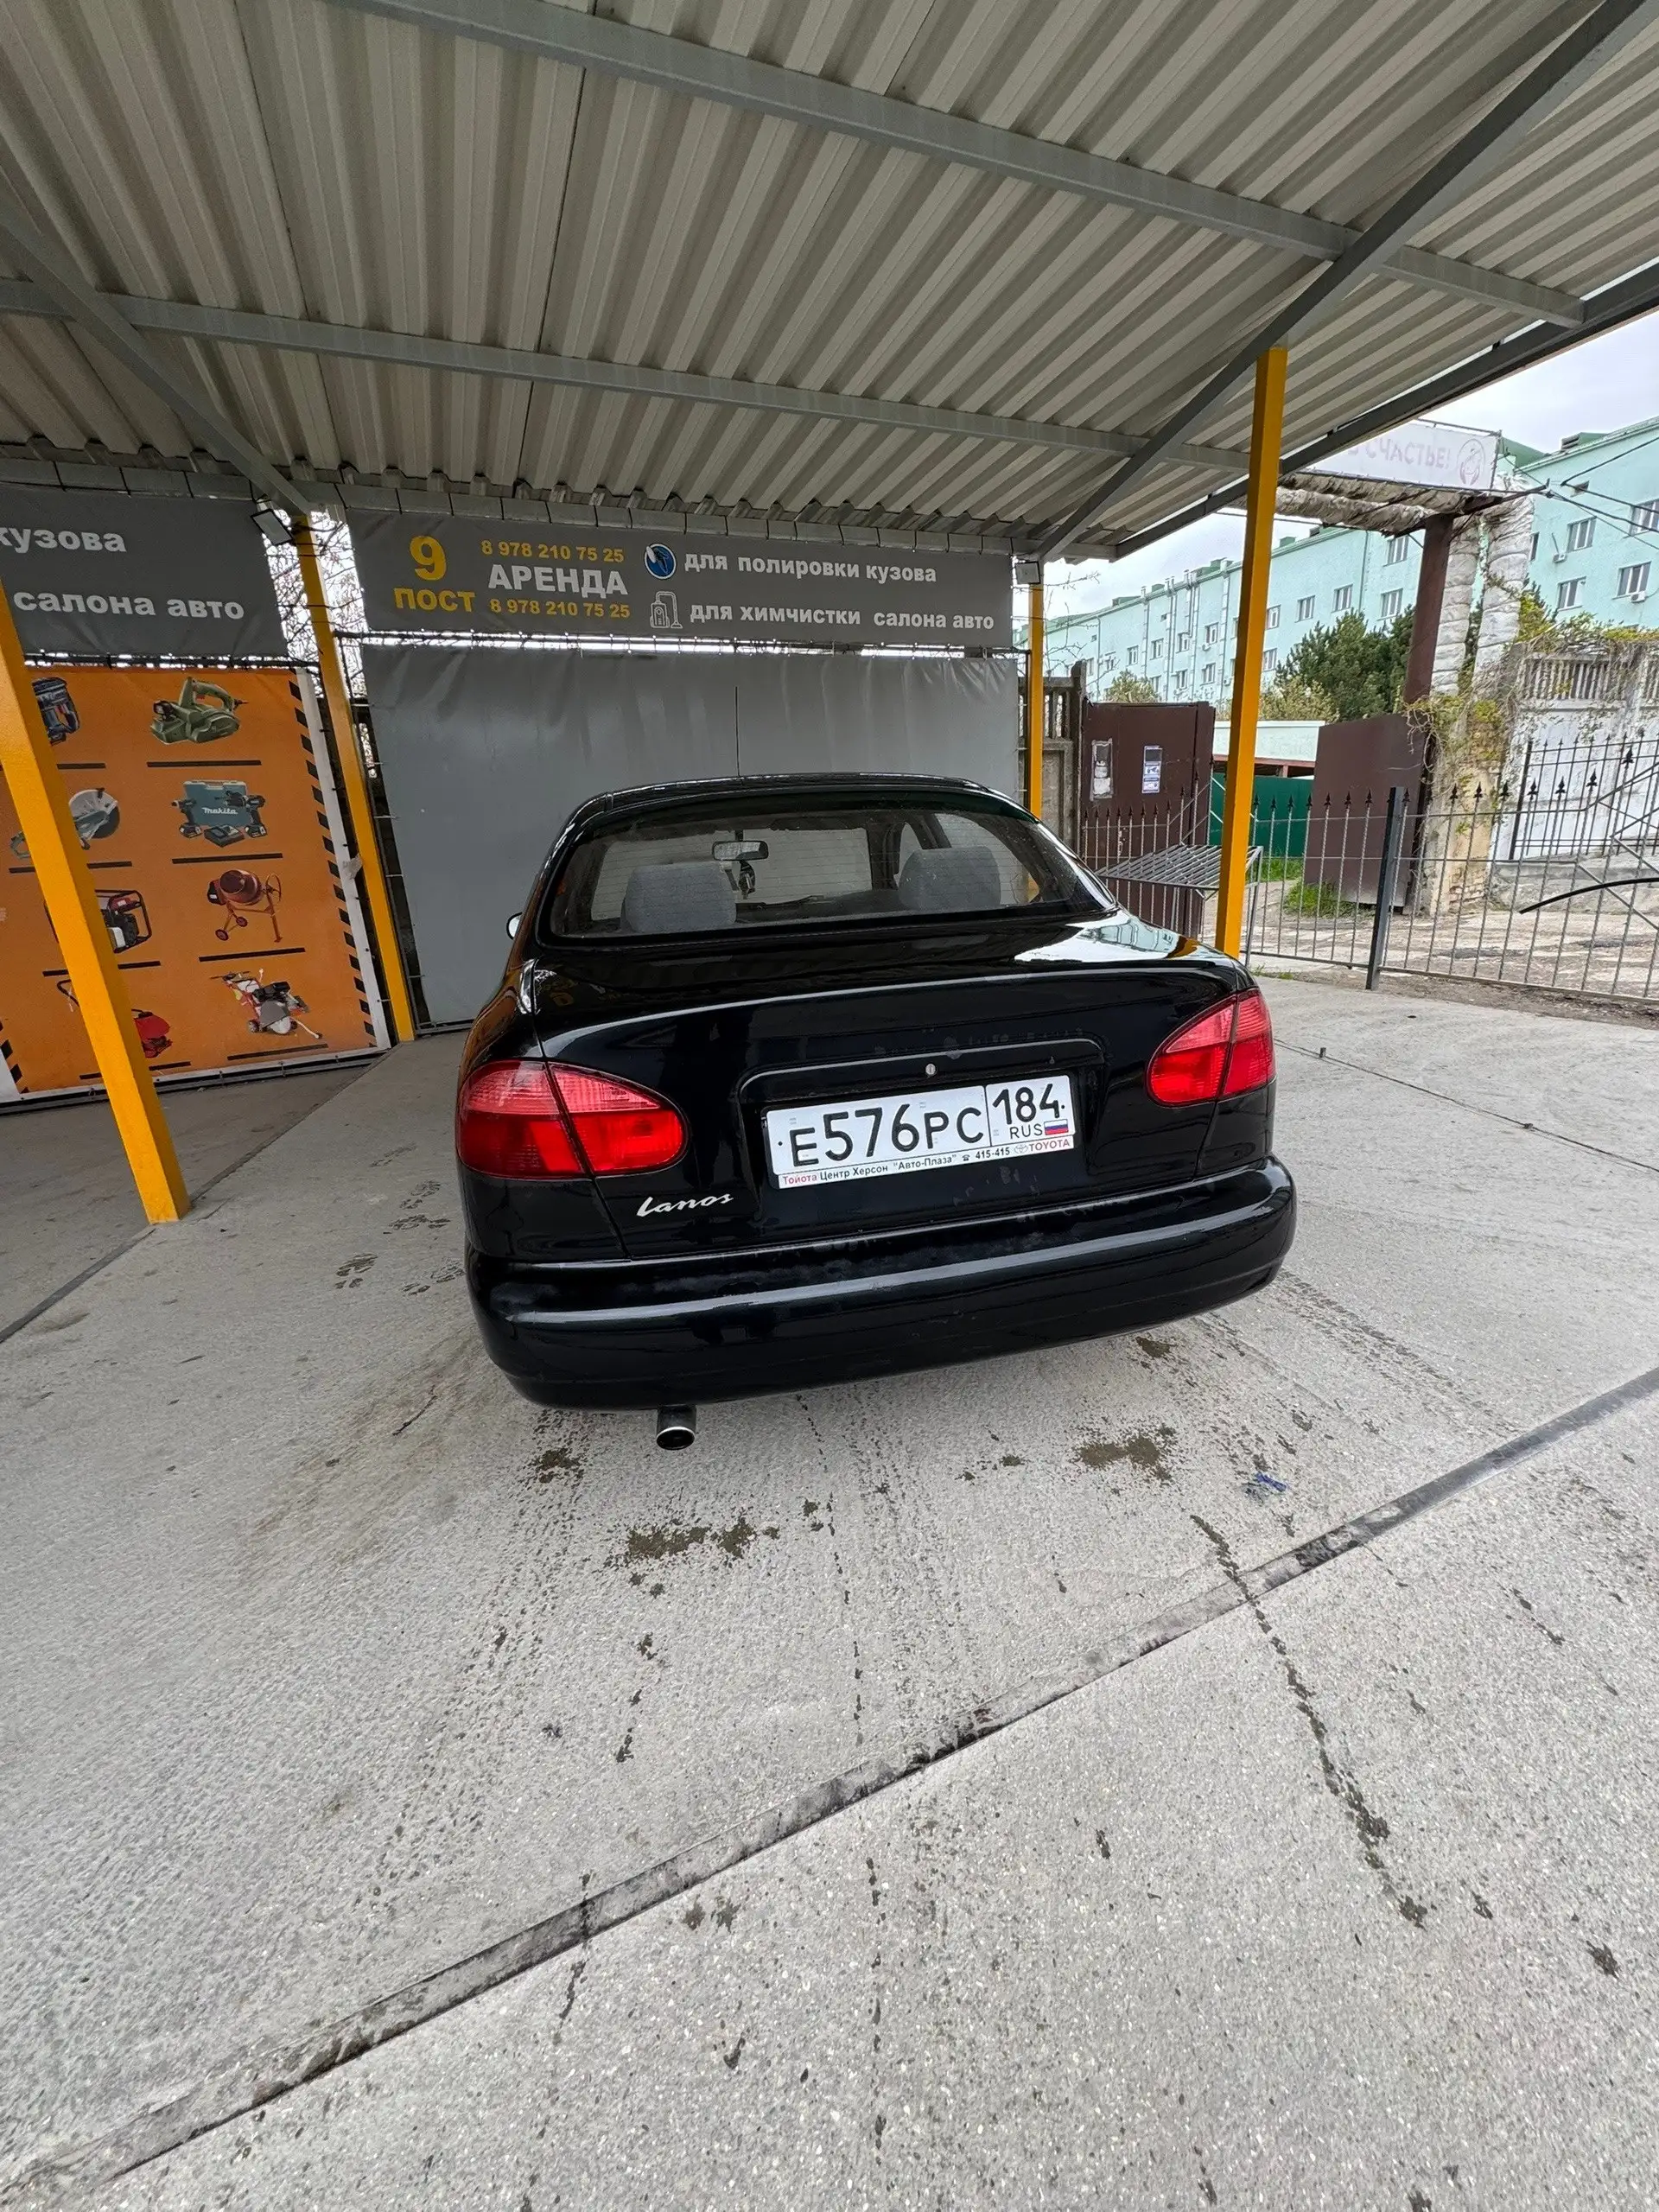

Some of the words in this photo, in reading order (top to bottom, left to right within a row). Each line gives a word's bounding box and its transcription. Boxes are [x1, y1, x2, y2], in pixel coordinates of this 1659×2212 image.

[410, 535, 447, 581] 9
[481, 539, 493, 555] 8
[498, 541, 532, 557] 978
[537, 543, 571, 560] 210
[576, 546, 598, 561] 75
[603, 548, 624, 563] 25
[488, 564, 628, 599] АРЕНДА
[684, 553, 728, 572] для
[738, 556, 860, 579] полировки
[866, 565, 937, 584] кузова
[14, 592, 156, 615] салона
[167, 599, 244, 620] авто
[489, 599, 502, 613] 8
[506, 599, 540, 614] 978
[545, 601, 578, 616] 210
[582, 602, 605, 617] 75
[609, 604, 631, 618] 25
[690, 604, 733, 623] для
[740, 606, 861, 625] химчистки
[874, 612, 946, 627] салона
[952, 614, 994, 629] авто
[992, 1084, 1059, 1125] 184
[1009, 1123, 1043, 1140] RUS
[782, 1173, 817, 1185] Тойота
[820, 1169, 850, 1181] Центр
[853, 1166, 888, 1177] Херсон
[975, 1147, 1010, 1160] 415-415
[1029, 1138, 1071, 1152] TOYOTA
